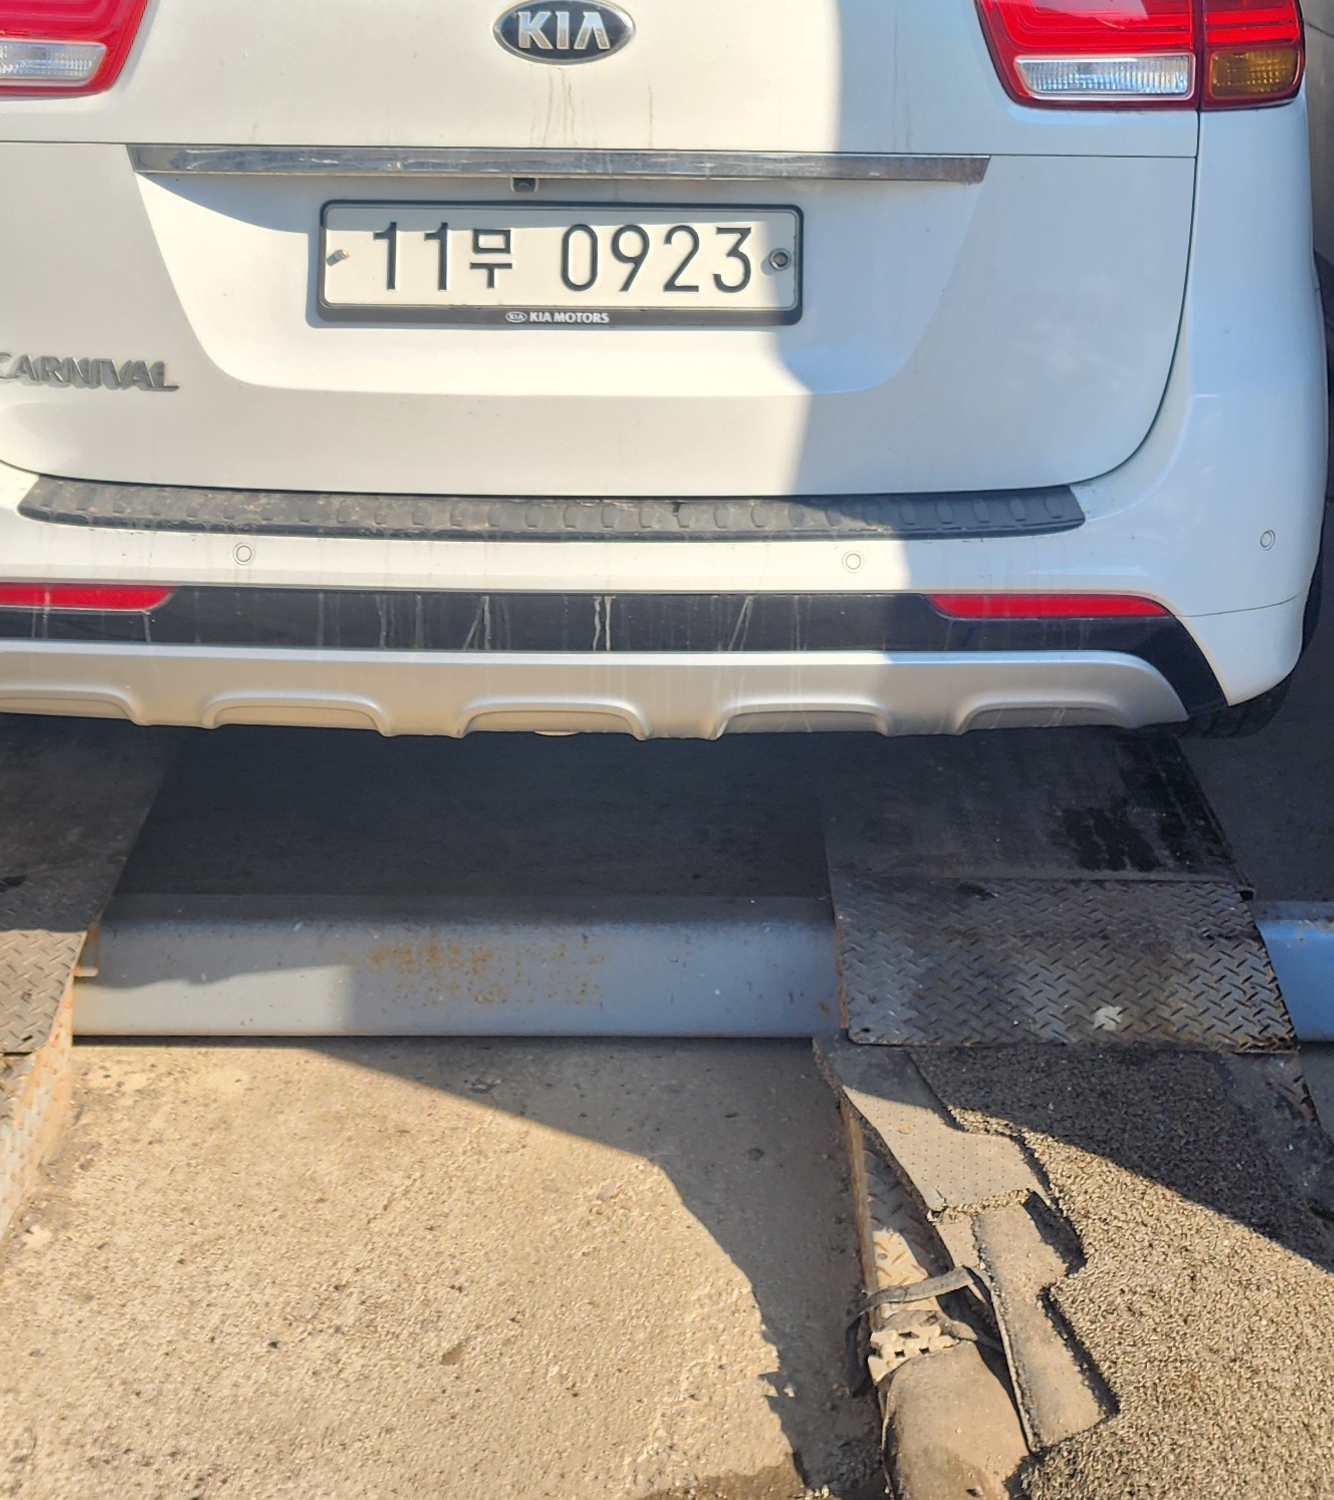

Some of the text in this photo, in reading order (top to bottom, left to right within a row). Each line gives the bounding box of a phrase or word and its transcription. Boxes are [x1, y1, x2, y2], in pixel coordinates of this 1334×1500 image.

[517, 11, 611, 50] KIA
[373, 221, 753, 294] 11무 0923
[529, 312, 553, 323] KIA
[553, 312, 610, 324] MOTORS
